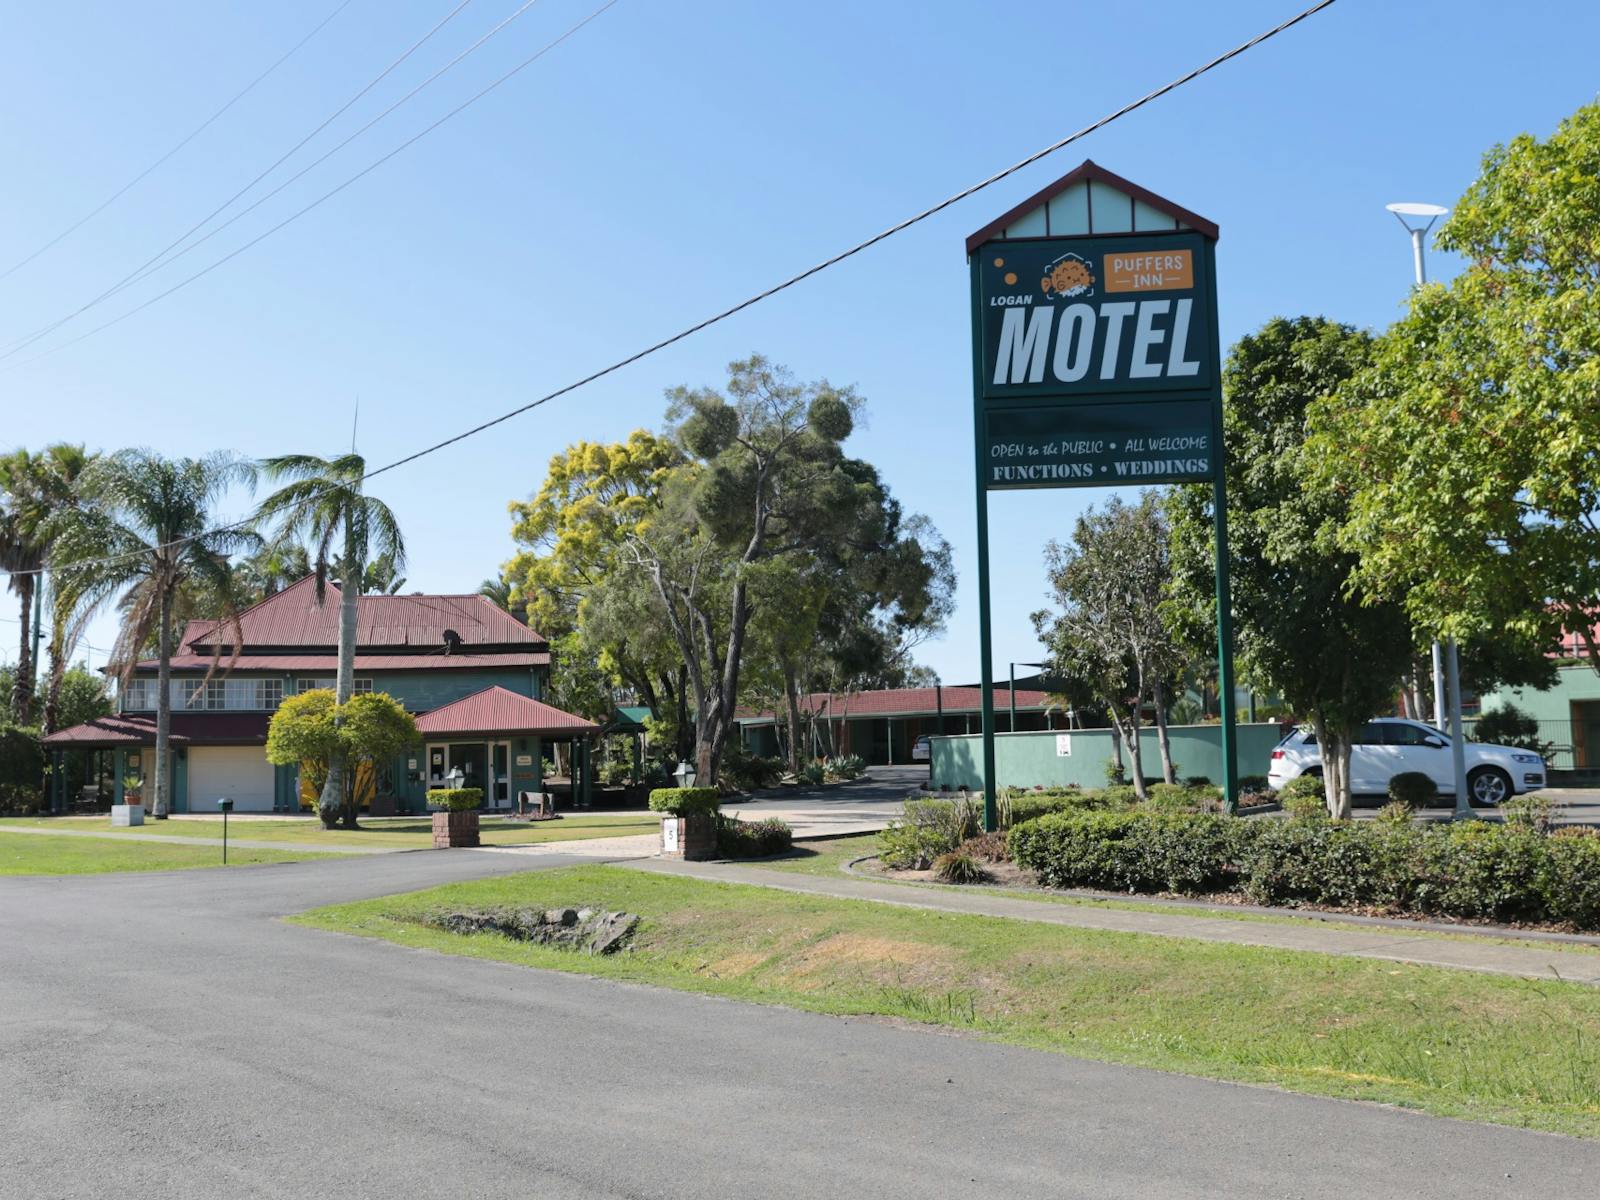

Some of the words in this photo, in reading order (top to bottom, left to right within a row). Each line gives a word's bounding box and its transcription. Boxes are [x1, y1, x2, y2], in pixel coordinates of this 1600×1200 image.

[1114, 255, 1183, 272] PUFFERS
[1132, 273, 1163, 288] INN
[990, 294, 1033, 307] LOGAN
[993, 299, 1200, 384] MOTEL
[991, 443, 1025, 458] OPEN
[1027, 446, 1039, 456] to
[1042, 443, 1058, 456] the
[1061, 440, 1104, 455] PUBLIC
[1124, 438, 1145, 452] ALL
[1148, 435, 1208, 451] WELCOME
[993, 463, 1094, 481] FUNCTIONS
[1113, 458, 1209, 476] WEDDINGS
[668, 830, 674, 840] 5
